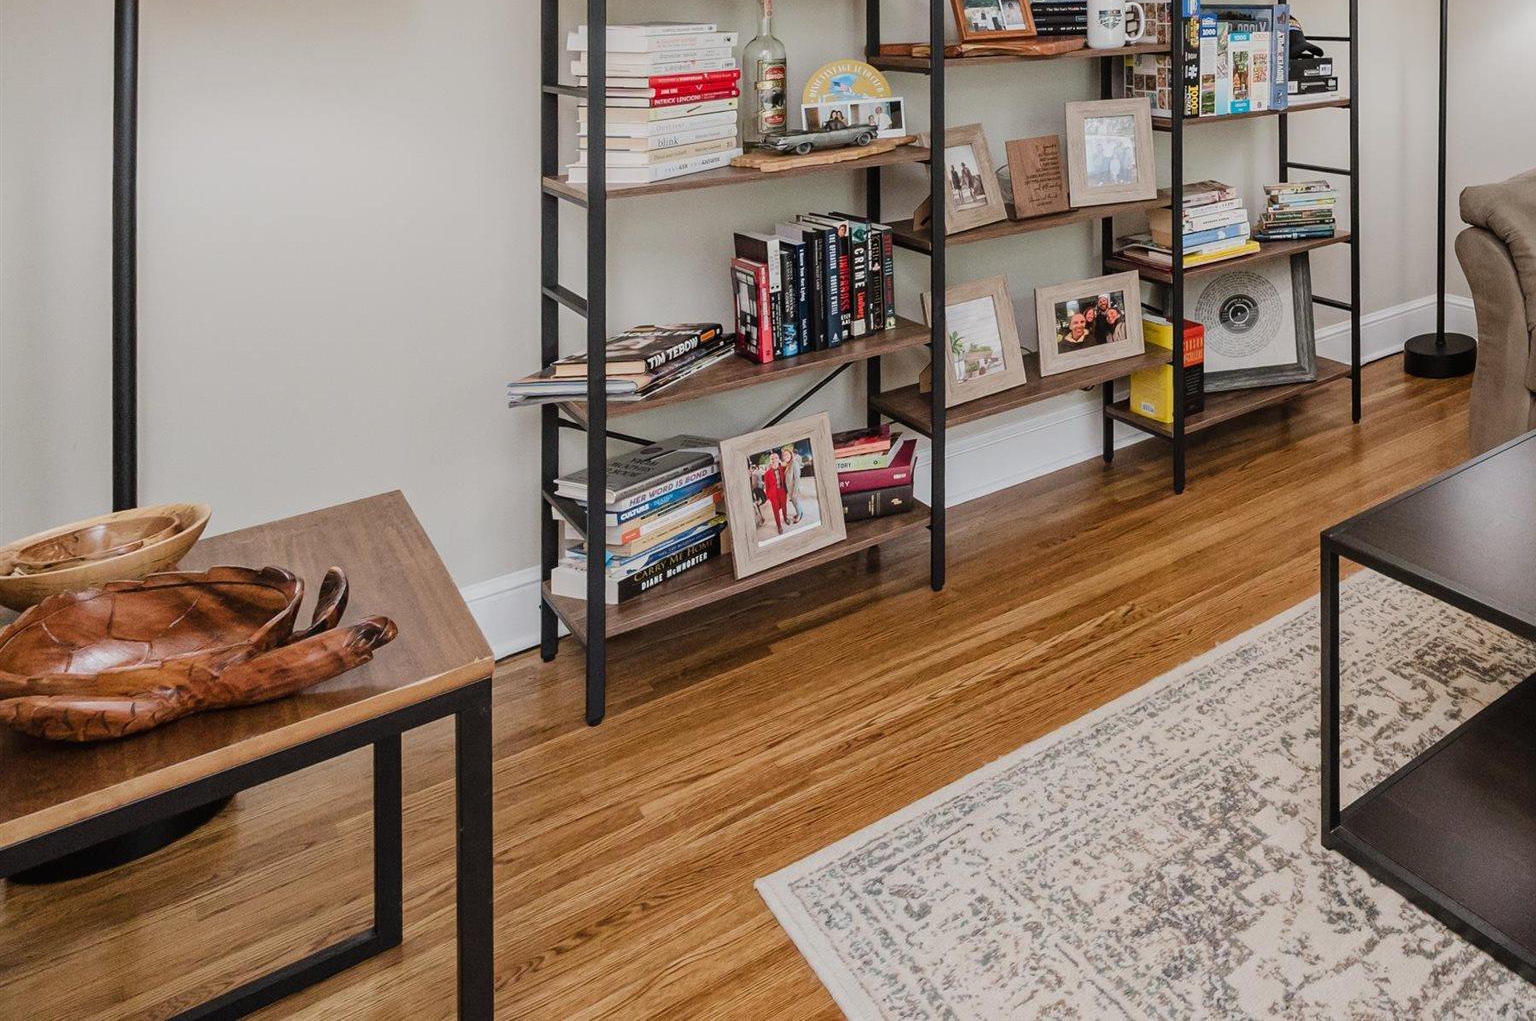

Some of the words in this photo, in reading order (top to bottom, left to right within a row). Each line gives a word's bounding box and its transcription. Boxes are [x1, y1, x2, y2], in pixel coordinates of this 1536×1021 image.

[1202, 28, 1216, 36] 1000
[820, 64, 851, 80] VINTAGE
[654, 98, 676, 106] PATRICK
[1188, 85, 1199, 109] 1000
[657, 135, 680, 147] blink
[701, 156, 720, 165] ANSWER
[828, 233, 836, 243] THE
[829, 244, 837, 269] OPERATOR
[855, 247, 865, 289] CRIME
[830, 275, 838, 295] ROBERT
[647, 353, 666, 370] TIM
[666, 336, 698, 360] TEBOW
[629, 493, 647, 507] HER
[648, 483, 674, 498] WORD
[675, 479, 685, 488] IS
[685, 469, 708, 484] BOND
[620, 503, 650, 521] CULTURE
[633, 560, 668, 582] CARRY
[669, 553, 684, 566] ME
[686, 538, 713, 557] HOME
[641, 573, 664, 591] DIANE
[666, 551, 708, 579] McWHORTER
